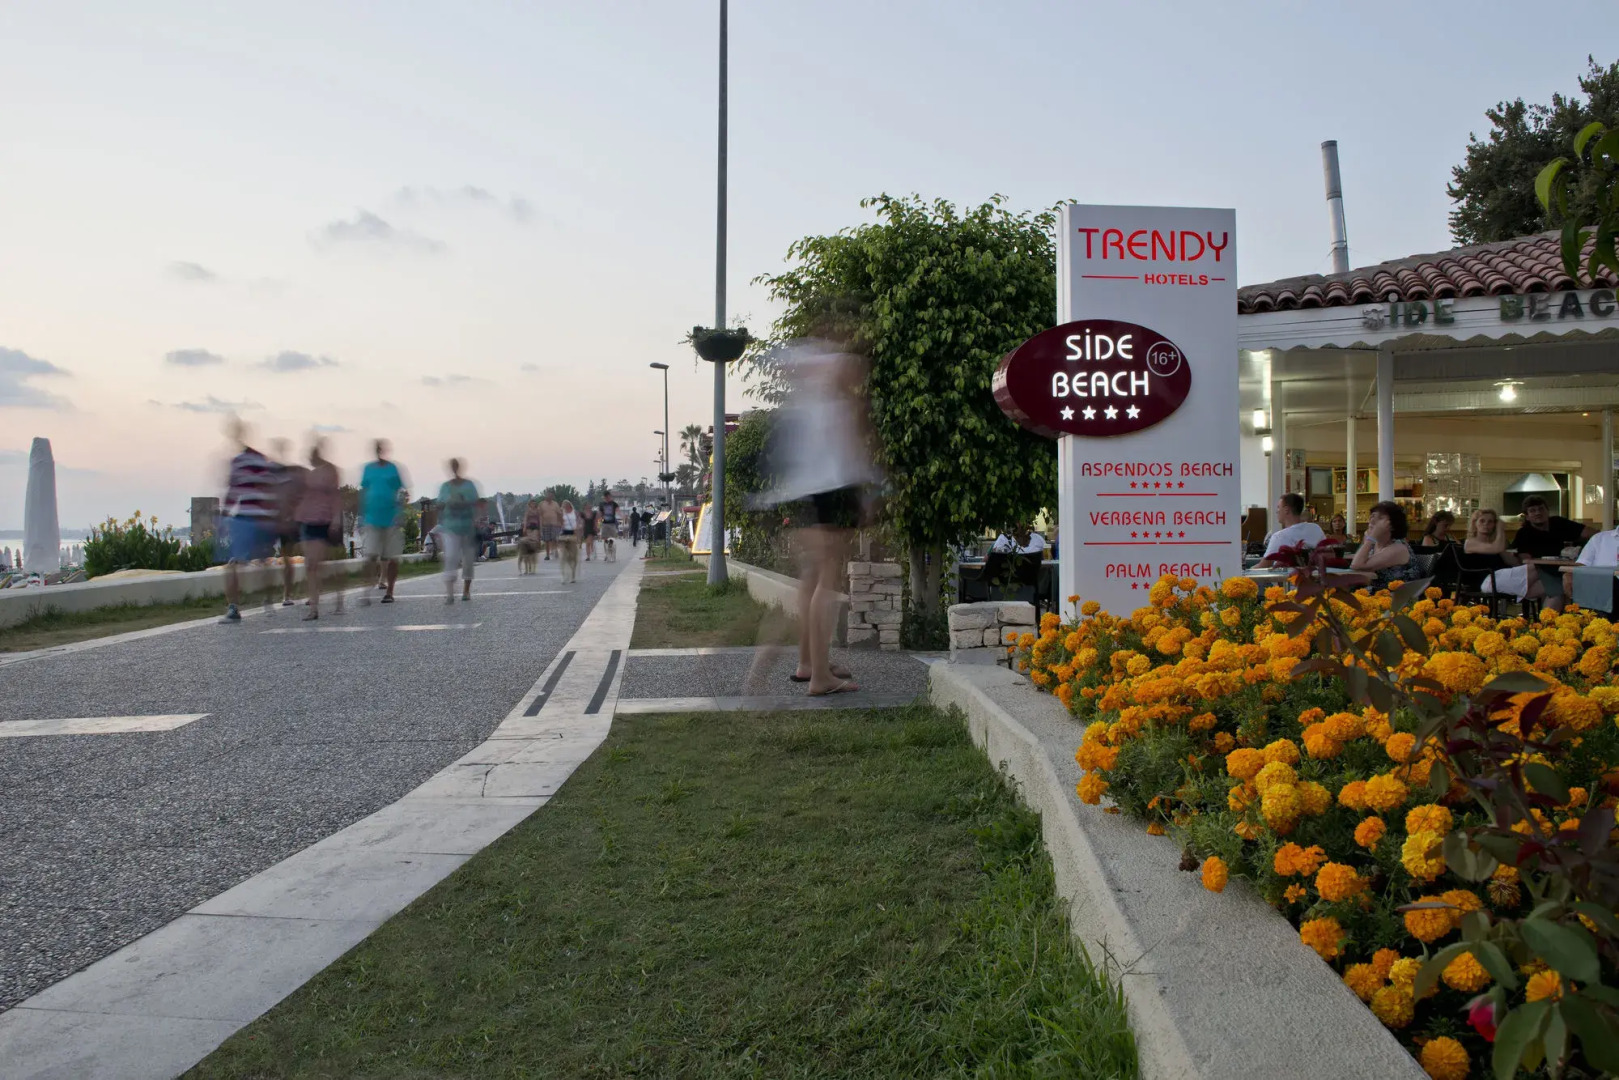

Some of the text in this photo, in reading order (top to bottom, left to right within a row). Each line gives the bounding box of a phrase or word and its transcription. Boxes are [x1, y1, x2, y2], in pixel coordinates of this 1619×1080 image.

[1078, 228, 1228, 262] TRENDY
[1144, 273, 1209, 286] HOTELS
[1151, 351, 1177, 365] 16+
[1052, 370, 1149, 398] BEACH
[1081, 462, 1233, 477] ASPENDOS BEACH
[1089, 511, 1227, 526] VERBENA BEACH
[1105, 563, 1212, 578] PALM BEACH
